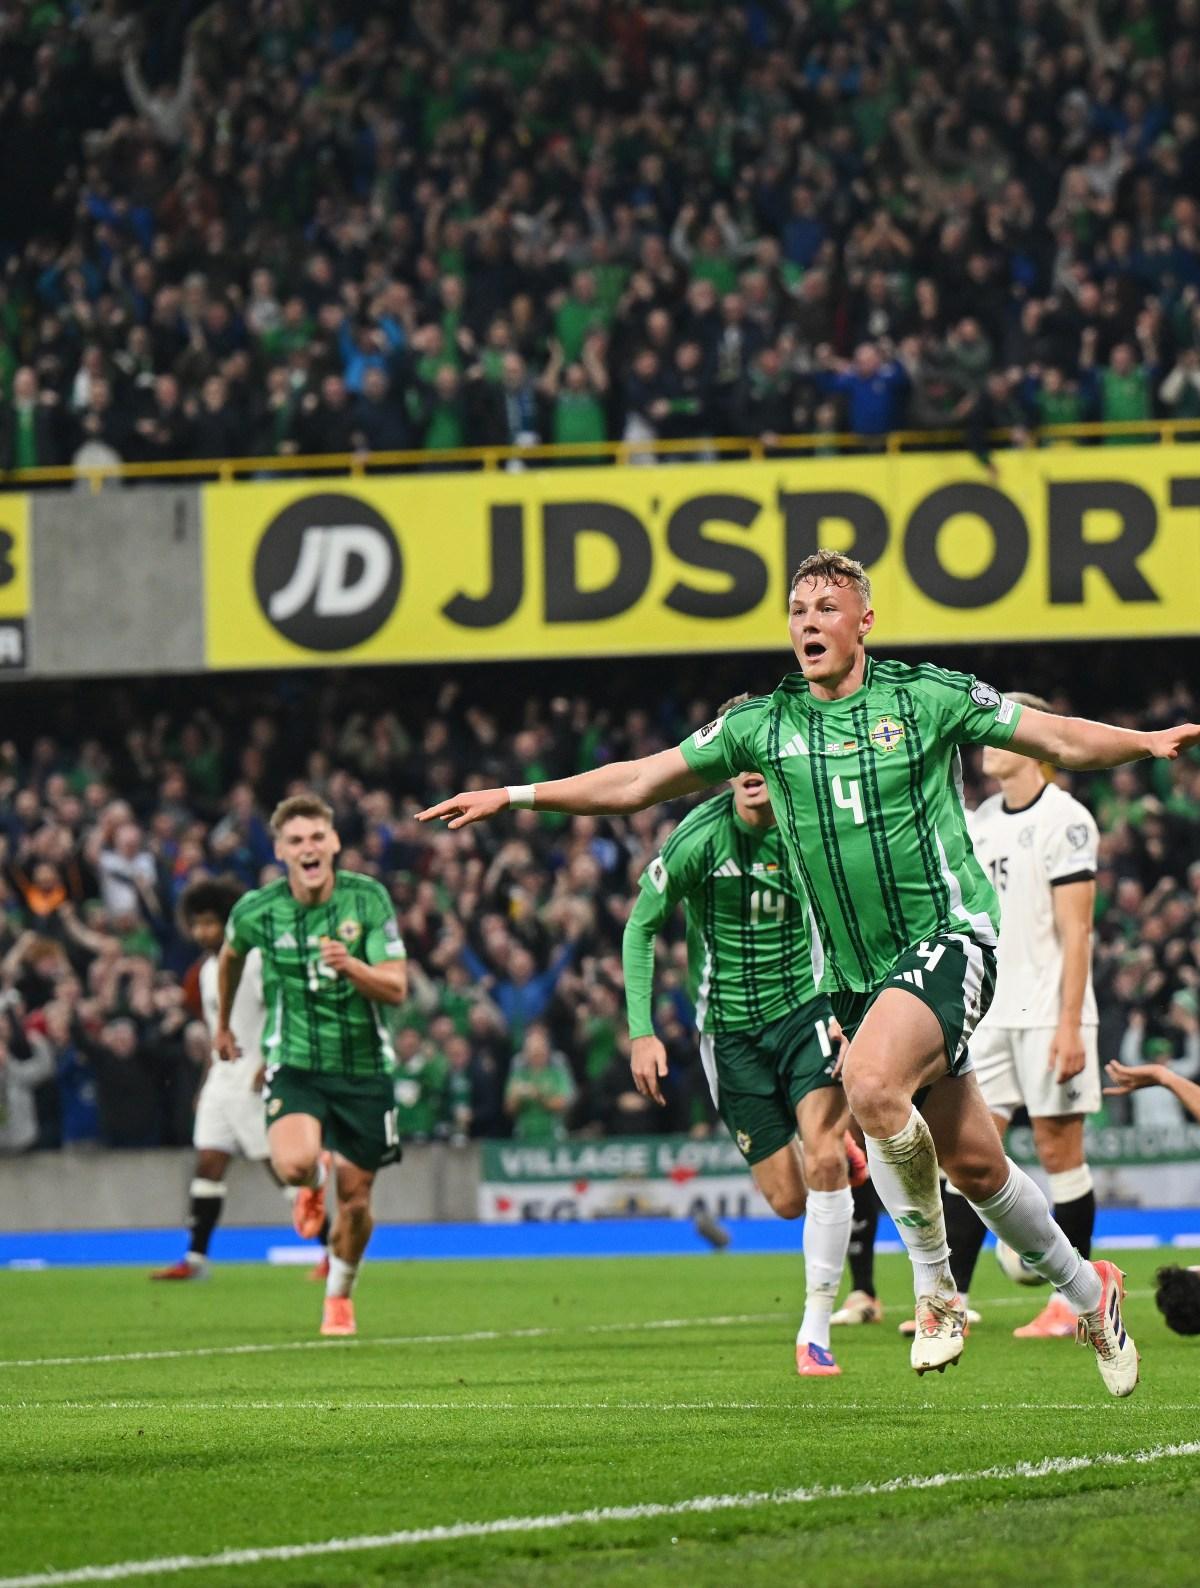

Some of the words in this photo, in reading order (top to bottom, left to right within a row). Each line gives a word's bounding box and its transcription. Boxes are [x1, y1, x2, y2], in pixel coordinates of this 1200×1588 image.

[270, 524, 392, 621] JD
[831, 774, 865, 825] 4
[750, 888, 786, 926] 14
[916, 941, 947, 972] 4
[501, 1144, 648, 1176] VILLAGE
[656, 1141, 747, 1174] LOYA
